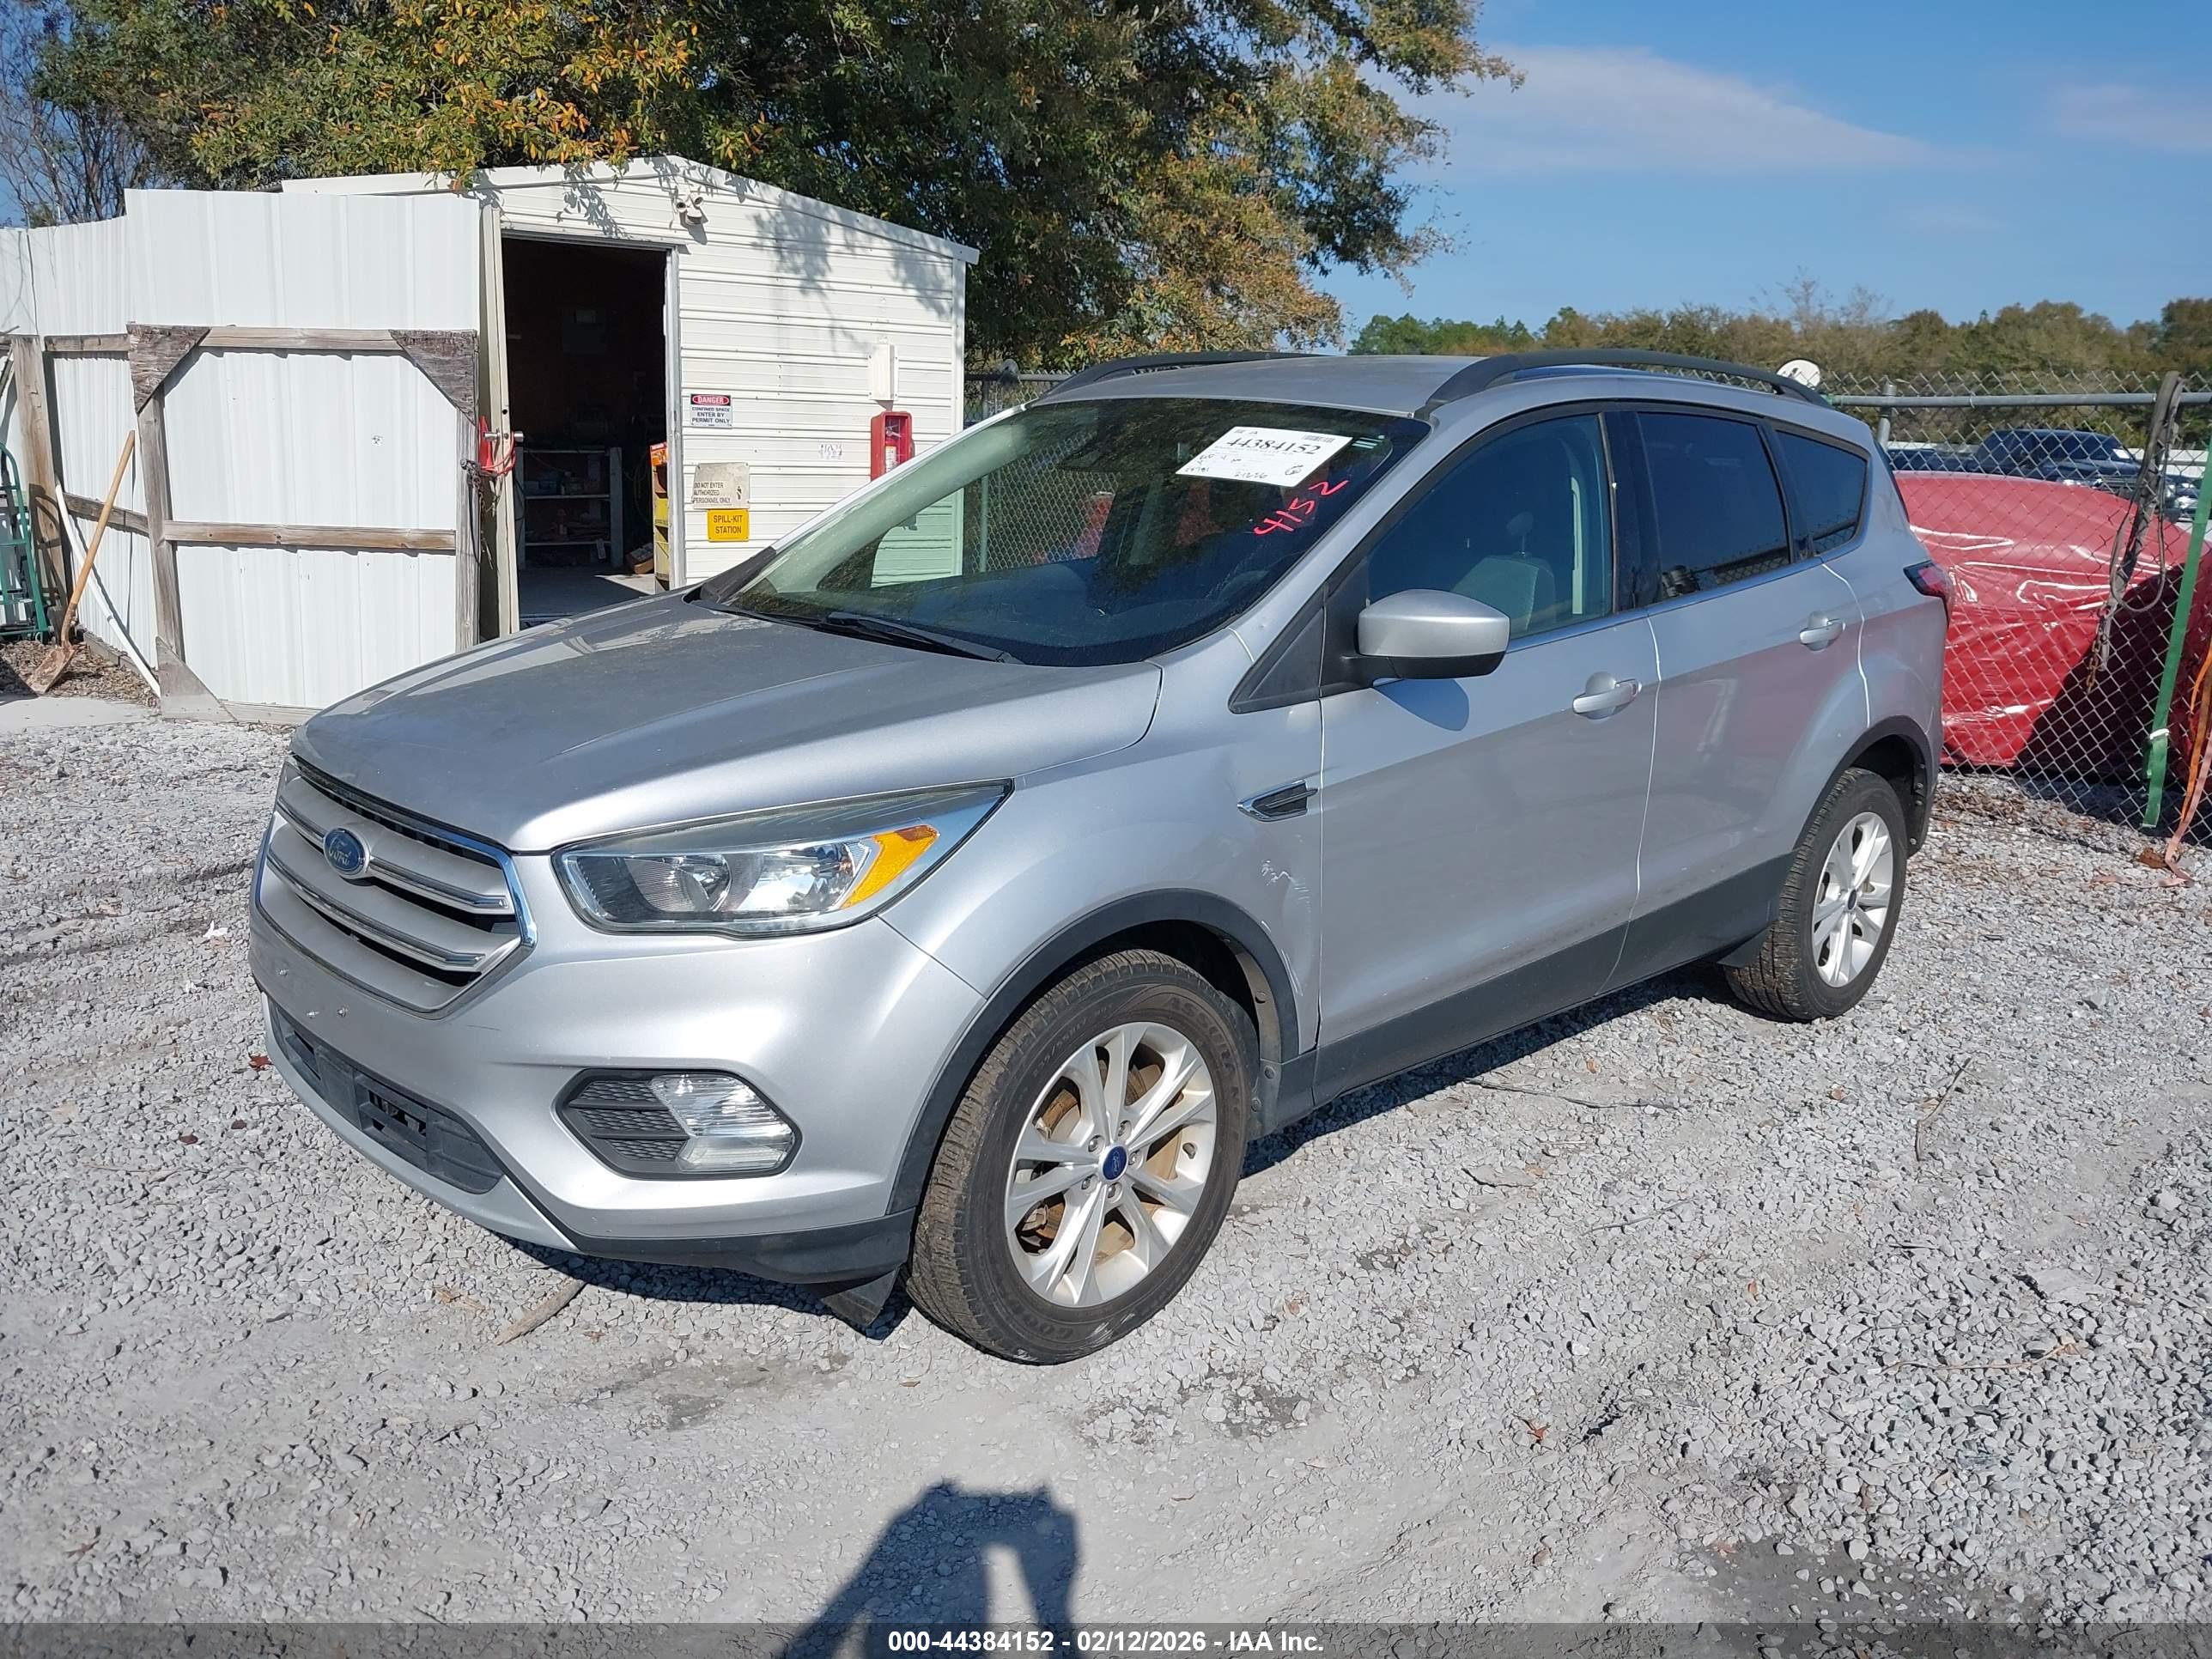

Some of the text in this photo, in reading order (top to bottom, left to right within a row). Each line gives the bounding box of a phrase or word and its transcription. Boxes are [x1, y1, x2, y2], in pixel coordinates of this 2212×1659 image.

[698, 396, 724, 404] DANGER
[1226, 437, 1322, 454] 44384152
[1253, 479, 1349, 536] 4152
[713, 514, 743, 523] SPILL-KIT
[714, 526, 742, 534] STATION
